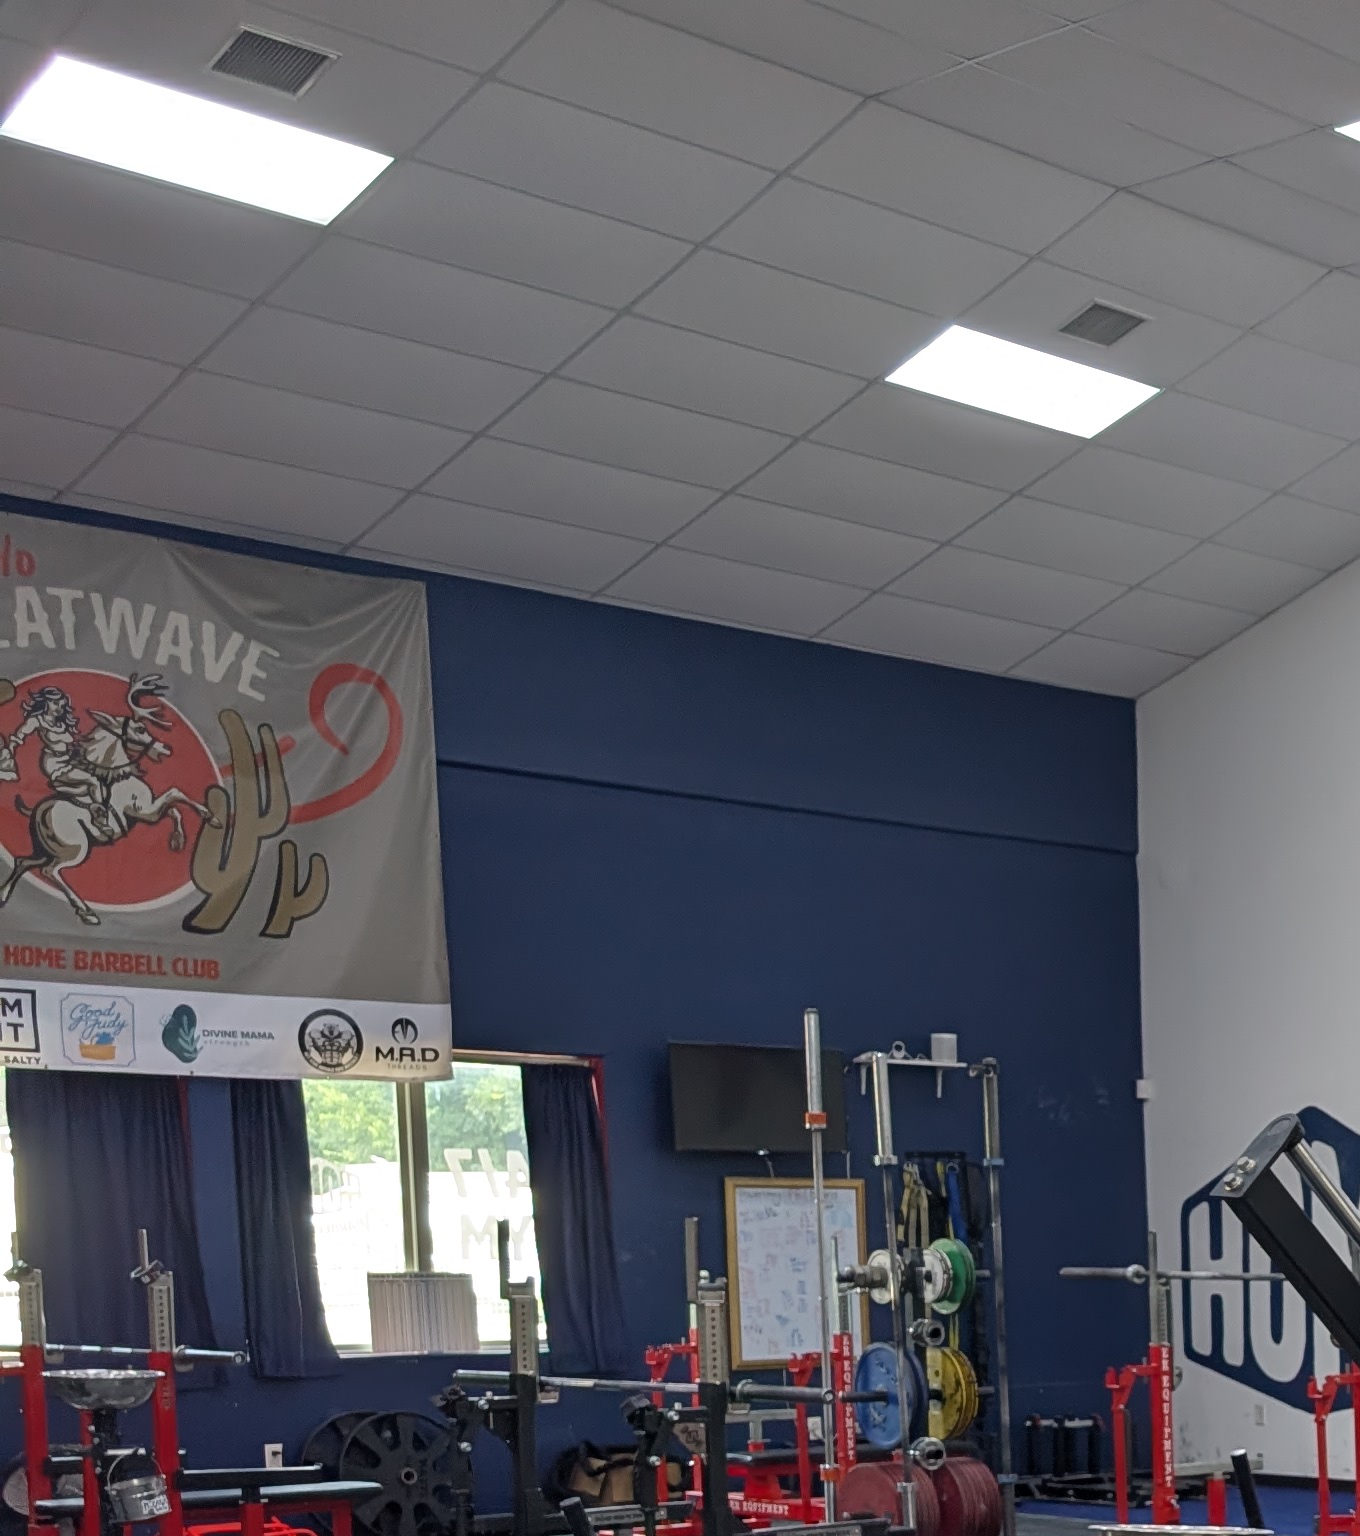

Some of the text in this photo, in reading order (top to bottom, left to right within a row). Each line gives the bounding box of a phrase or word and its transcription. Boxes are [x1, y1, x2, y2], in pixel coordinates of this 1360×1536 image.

[3, 944, 221, 980] HOME BARBELL CLUB
[202, 1029, 275, 1041] DIVINE MAMA
[4, 1055, 41, 1065] SALTY
[843, 1360, 855, 1461] EQPMENT
[1162, 1375, 1172, 1488] EQUIPMENT
[742, 1500, 789, 1515] EQUIPMENT
